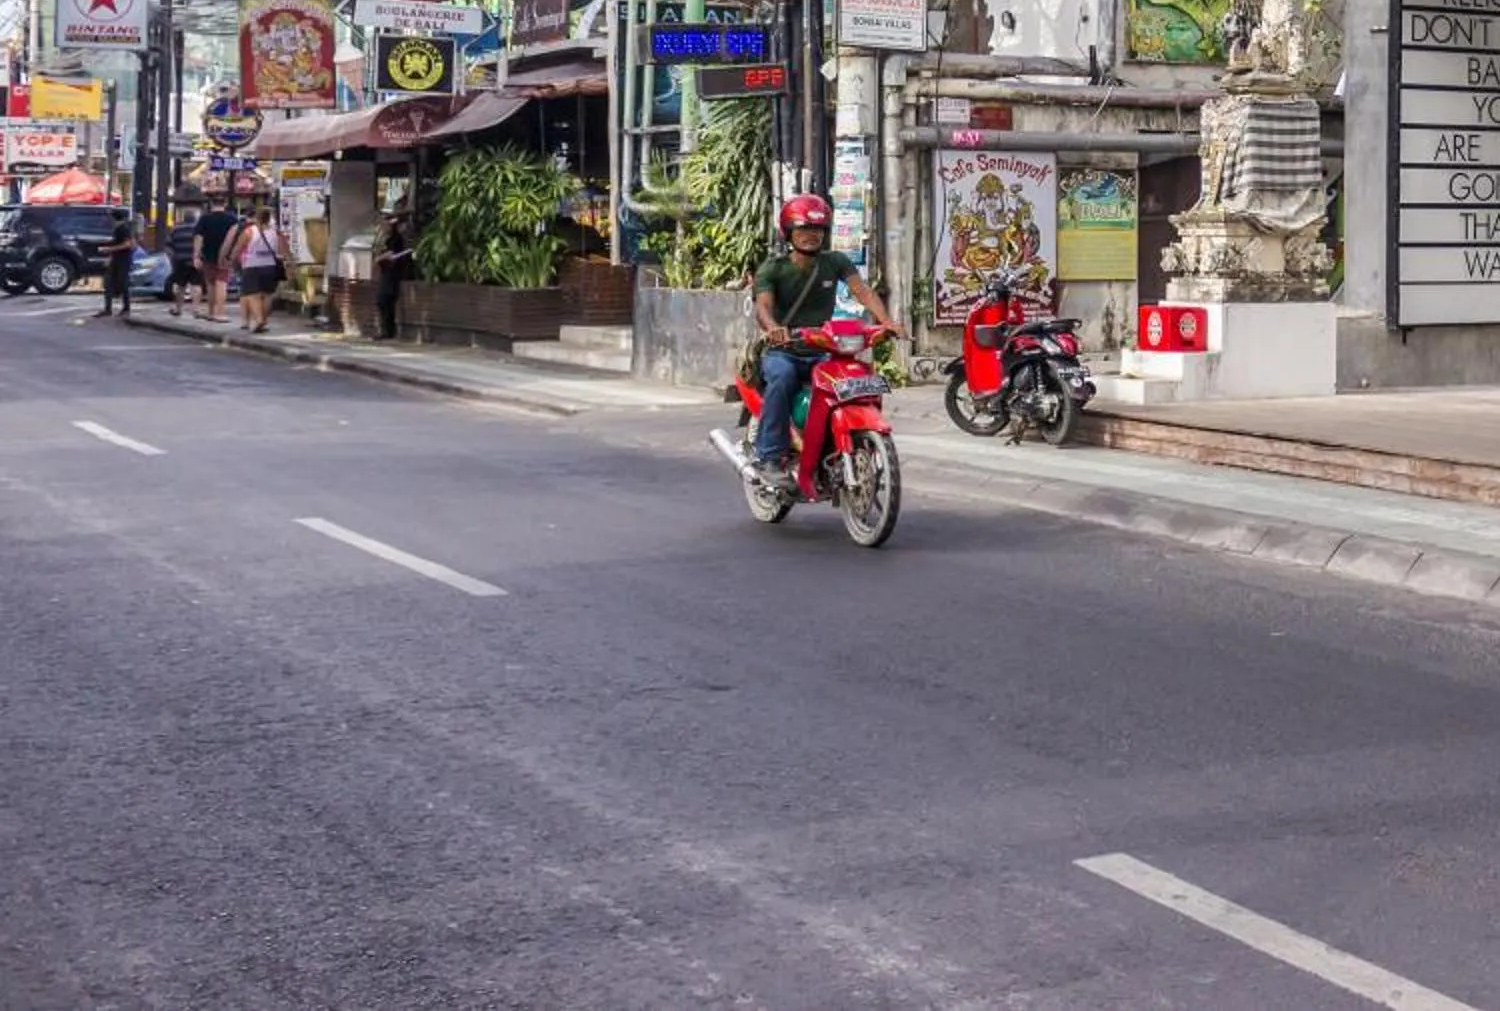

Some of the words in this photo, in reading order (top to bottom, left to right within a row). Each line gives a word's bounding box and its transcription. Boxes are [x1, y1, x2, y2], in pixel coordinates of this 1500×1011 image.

[415, 19, 445, 30] BALI
[1411, 14, 1494, 47] DON'T
[1434, 133, 1480, 163] ARE
[938, 161, 973, 184] Cafe
[977, 153, 1053, 186] Seminyak
